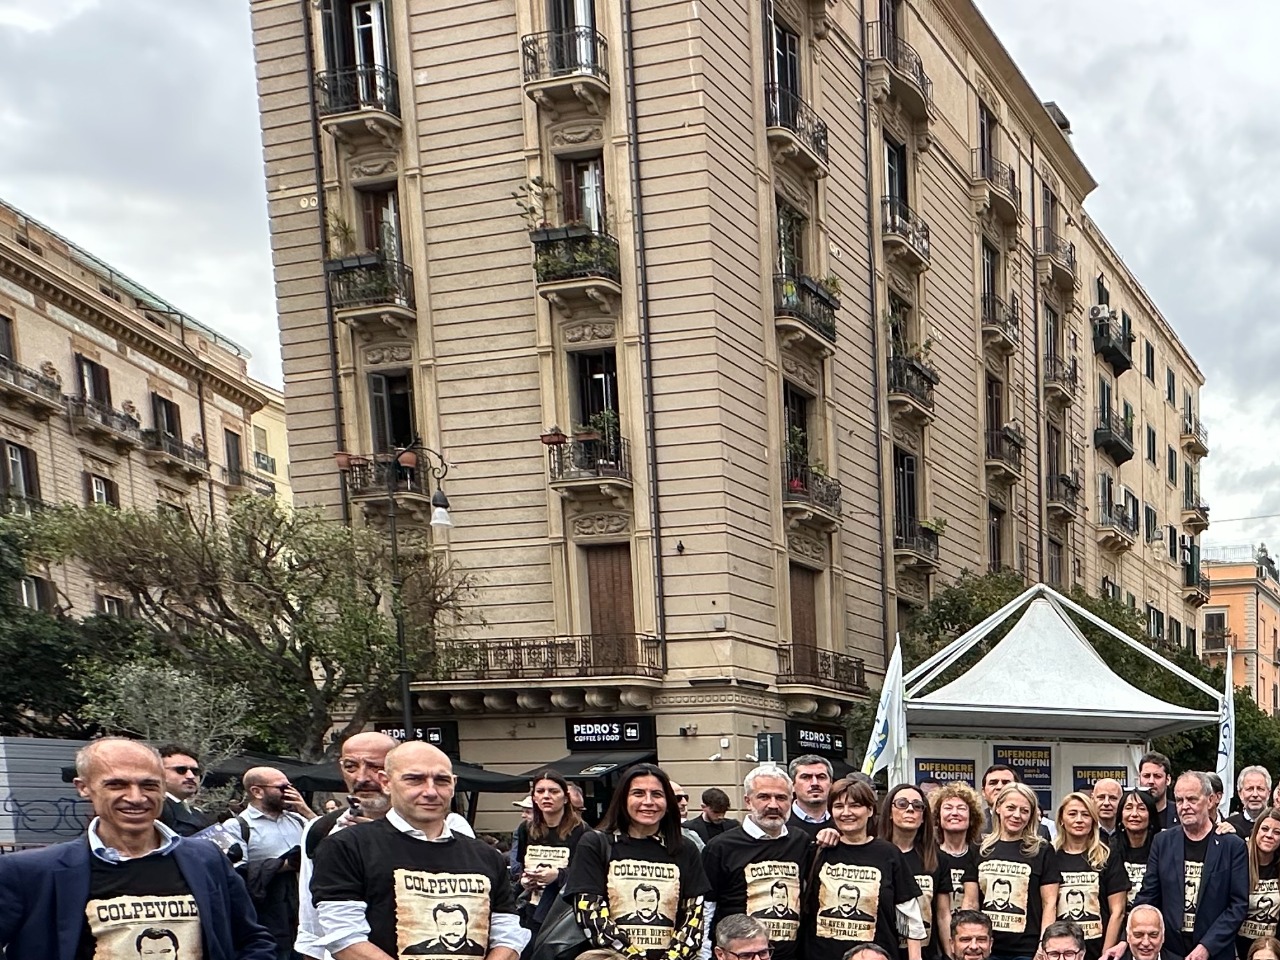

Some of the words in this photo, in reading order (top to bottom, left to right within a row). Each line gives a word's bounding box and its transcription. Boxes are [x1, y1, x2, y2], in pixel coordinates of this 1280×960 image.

[574, 723, 620, 734] PEDRO'S
[800, 730, 831, 743] PEDRO'S
[997, 749, 1050, 759] DIFENDERE
[919, 762, 974, 772] DIFENDERE
[1013, 758, 1050, 767] CONFINI
[934, 771, 974, 780] CONFINI
[1076, 770, 1127, 779] DIFENDERE
[613, 864, 675, 879] COLPEVOLE
[750, 864, 798, 878] COLPEVOLE
[826, 866, 877, 880] COLPEVOLE
[404, 874, 485, 894] COLPEVOLE
[97, 900, 198, 922] COLPEVOLE
